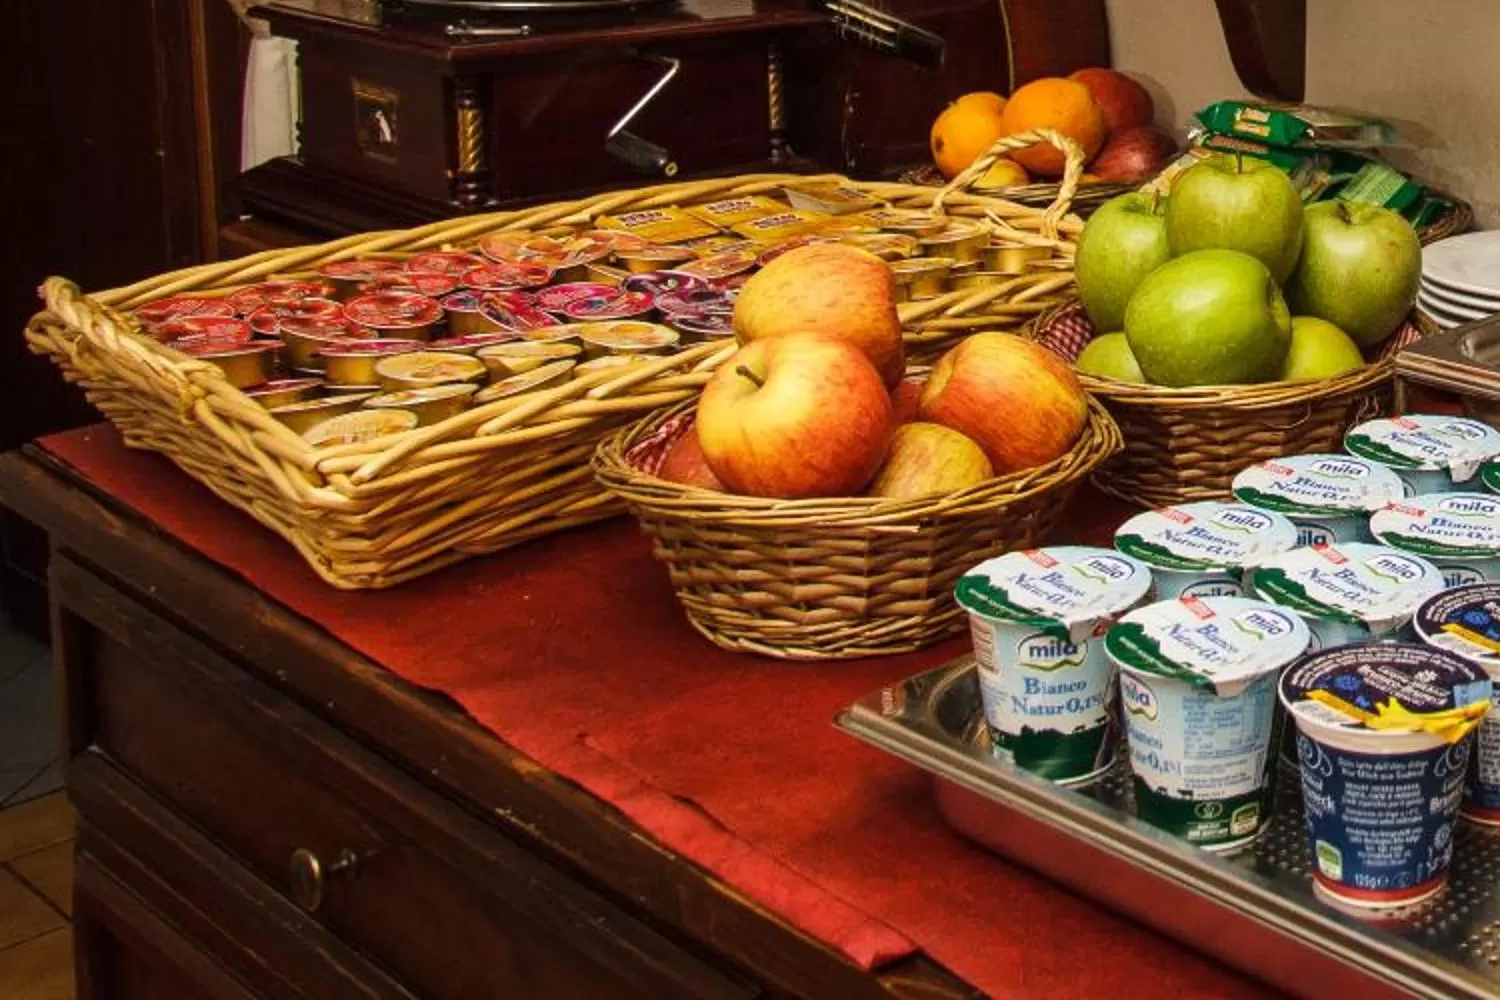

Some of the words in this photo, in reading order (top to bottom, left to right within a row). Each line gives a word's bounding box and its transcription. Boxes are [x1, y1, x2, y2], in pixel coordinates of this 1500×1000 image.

[1319, 461, 1363, 476] mila
[1449, 501, 1496, 514] mila
[1223, 511, 1265, 529] mila
[1028, 639, 1079, 659] mila
[1023, 676, 1088, 695] Bianco
[1011, 695, 1065, 716] Natur
